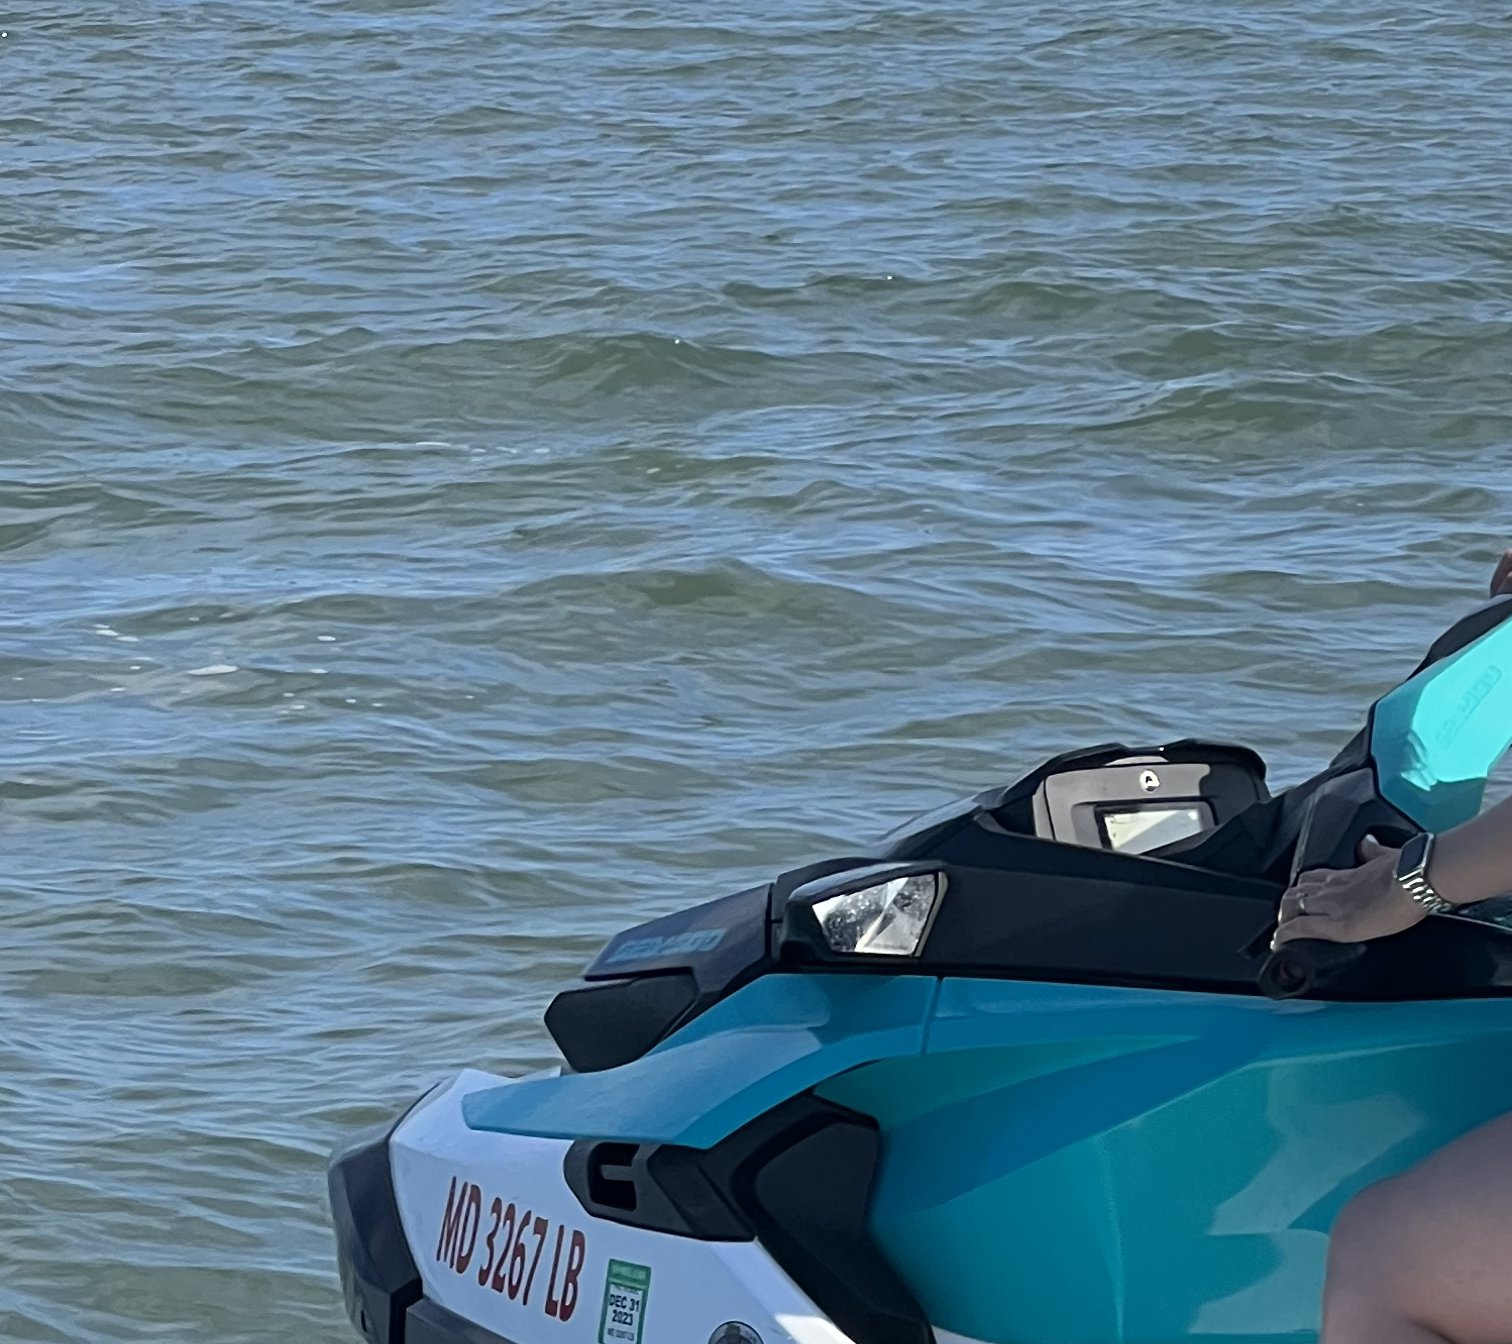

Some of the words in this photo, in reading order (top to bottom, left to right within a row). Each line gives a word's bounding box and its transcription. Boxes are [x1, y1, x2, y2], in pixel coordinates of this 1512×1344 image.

[436, 1175, 482, 1274] MD
[477, 1196, 549, 1306] 3267
[544, 1224, 586, 1322] LB
[609, 1293, 628, 1309] DEC
[629, 1298, 641, 1312] 31
